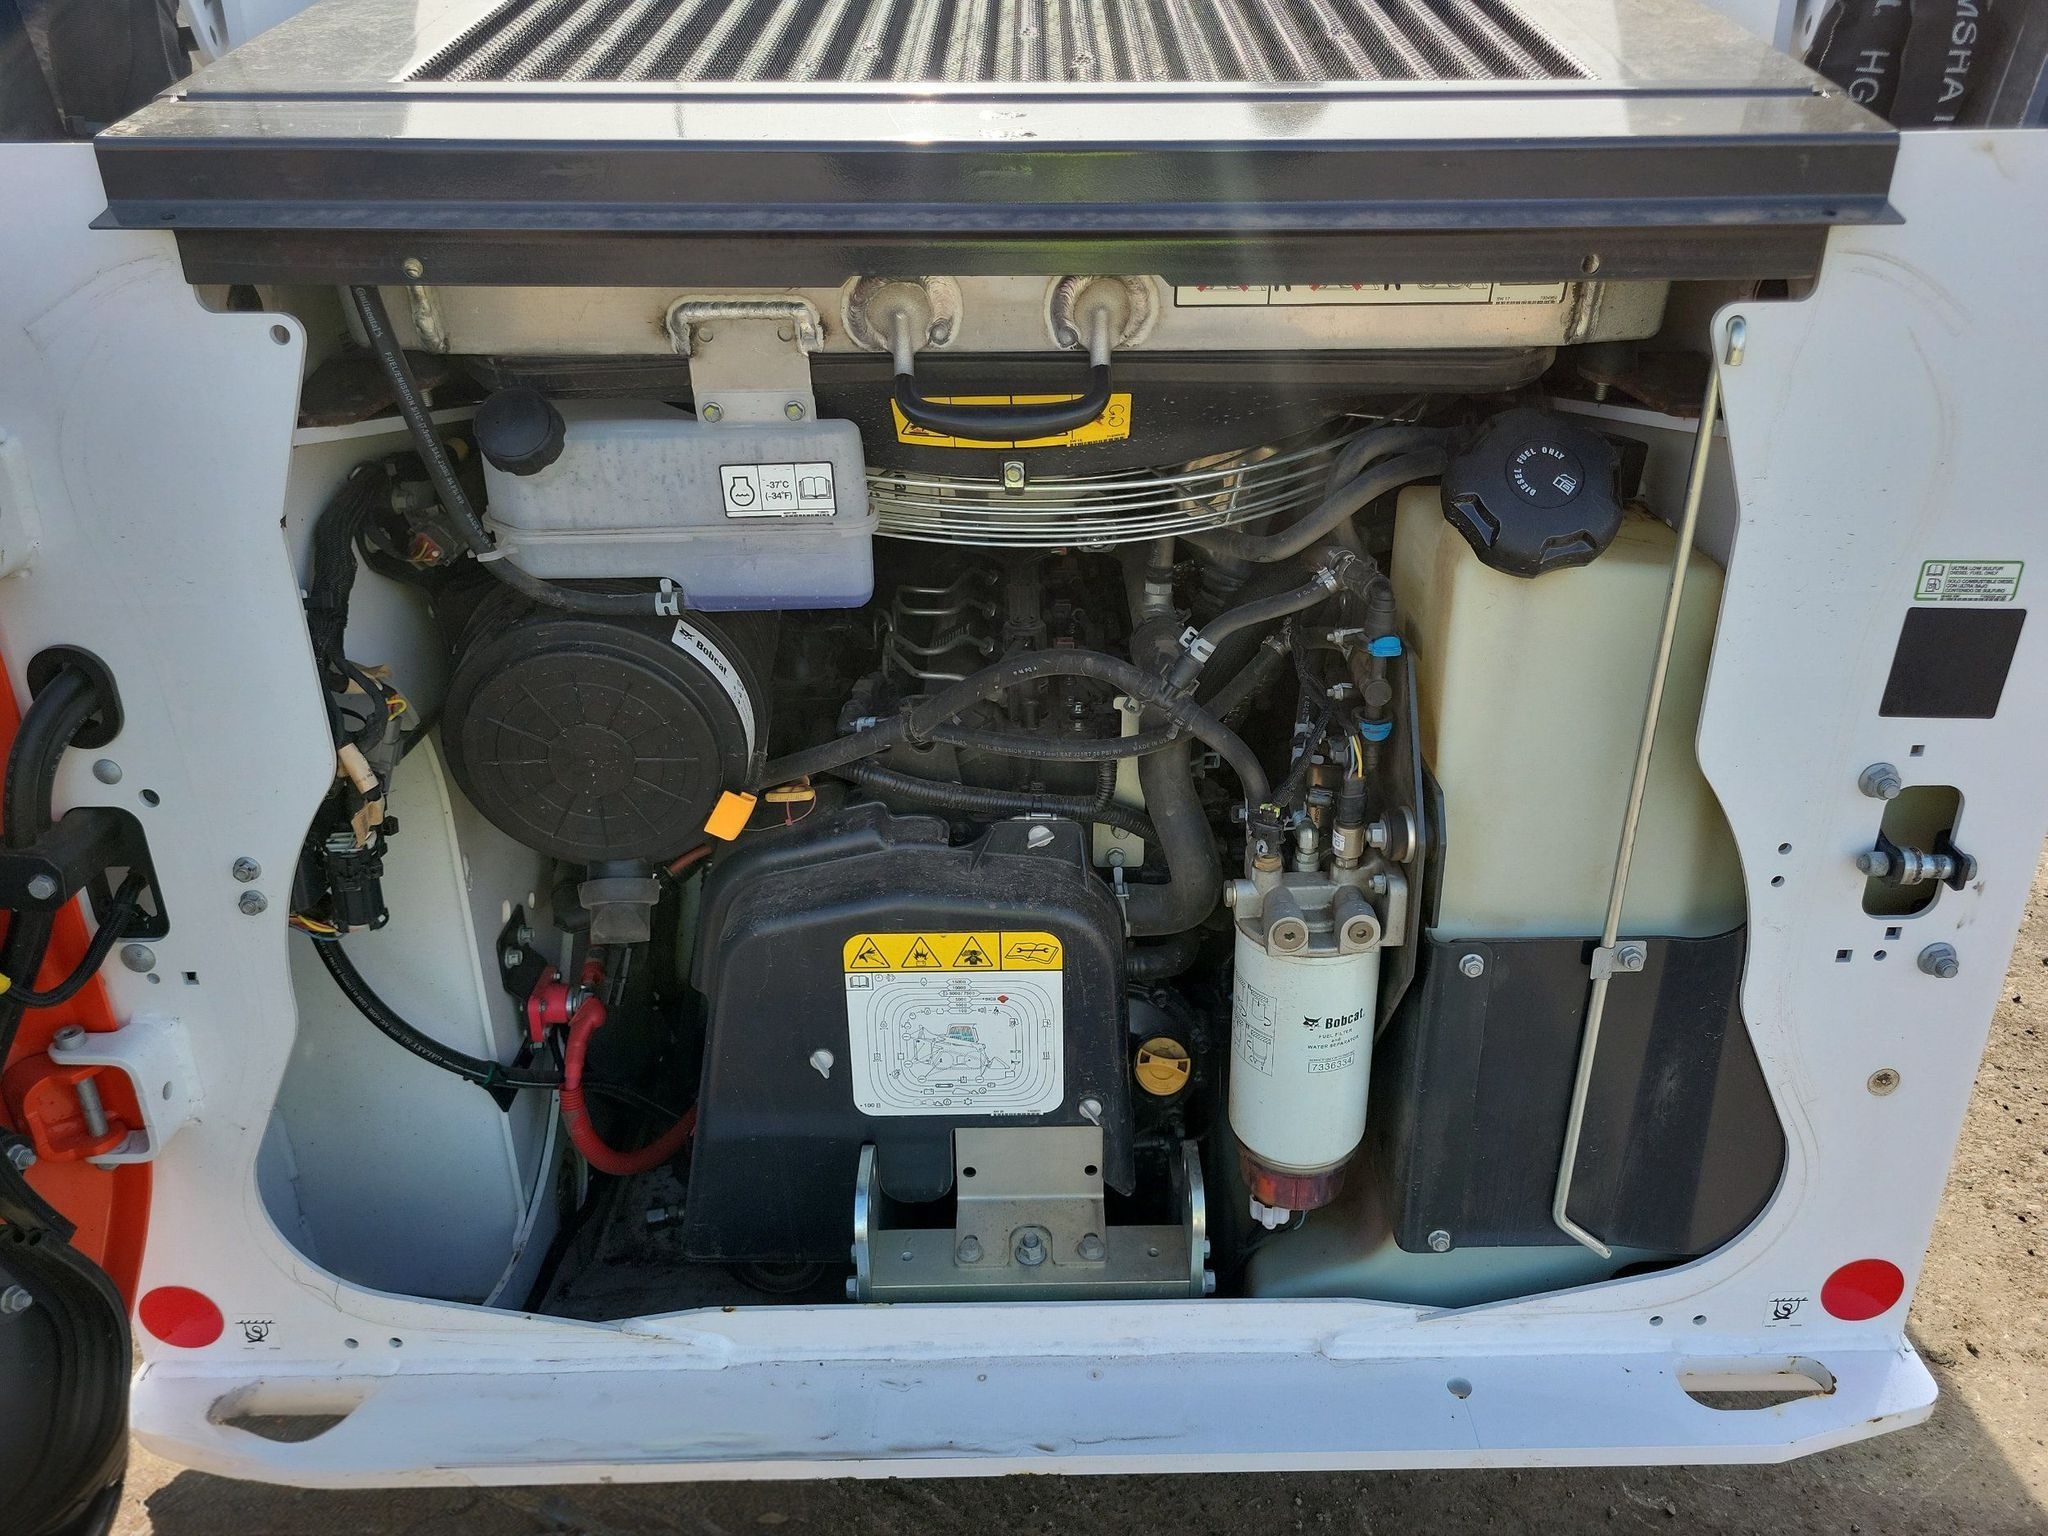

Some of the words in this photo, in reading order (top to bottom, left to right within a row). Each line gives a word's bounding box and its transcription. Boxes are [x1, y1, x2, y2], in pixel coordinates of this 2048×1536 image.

[1516, 448, 1537, 465] FUEL
[1541, 446, 1565, 460] ONLY
[1513, 468, 1537, 496] DIESEL
[696, 640, 728, 675] Bobcat
[1325, 1008, 1363, 1029] Bobcat
[1312, 1057, 1352, 1071] 7336334
